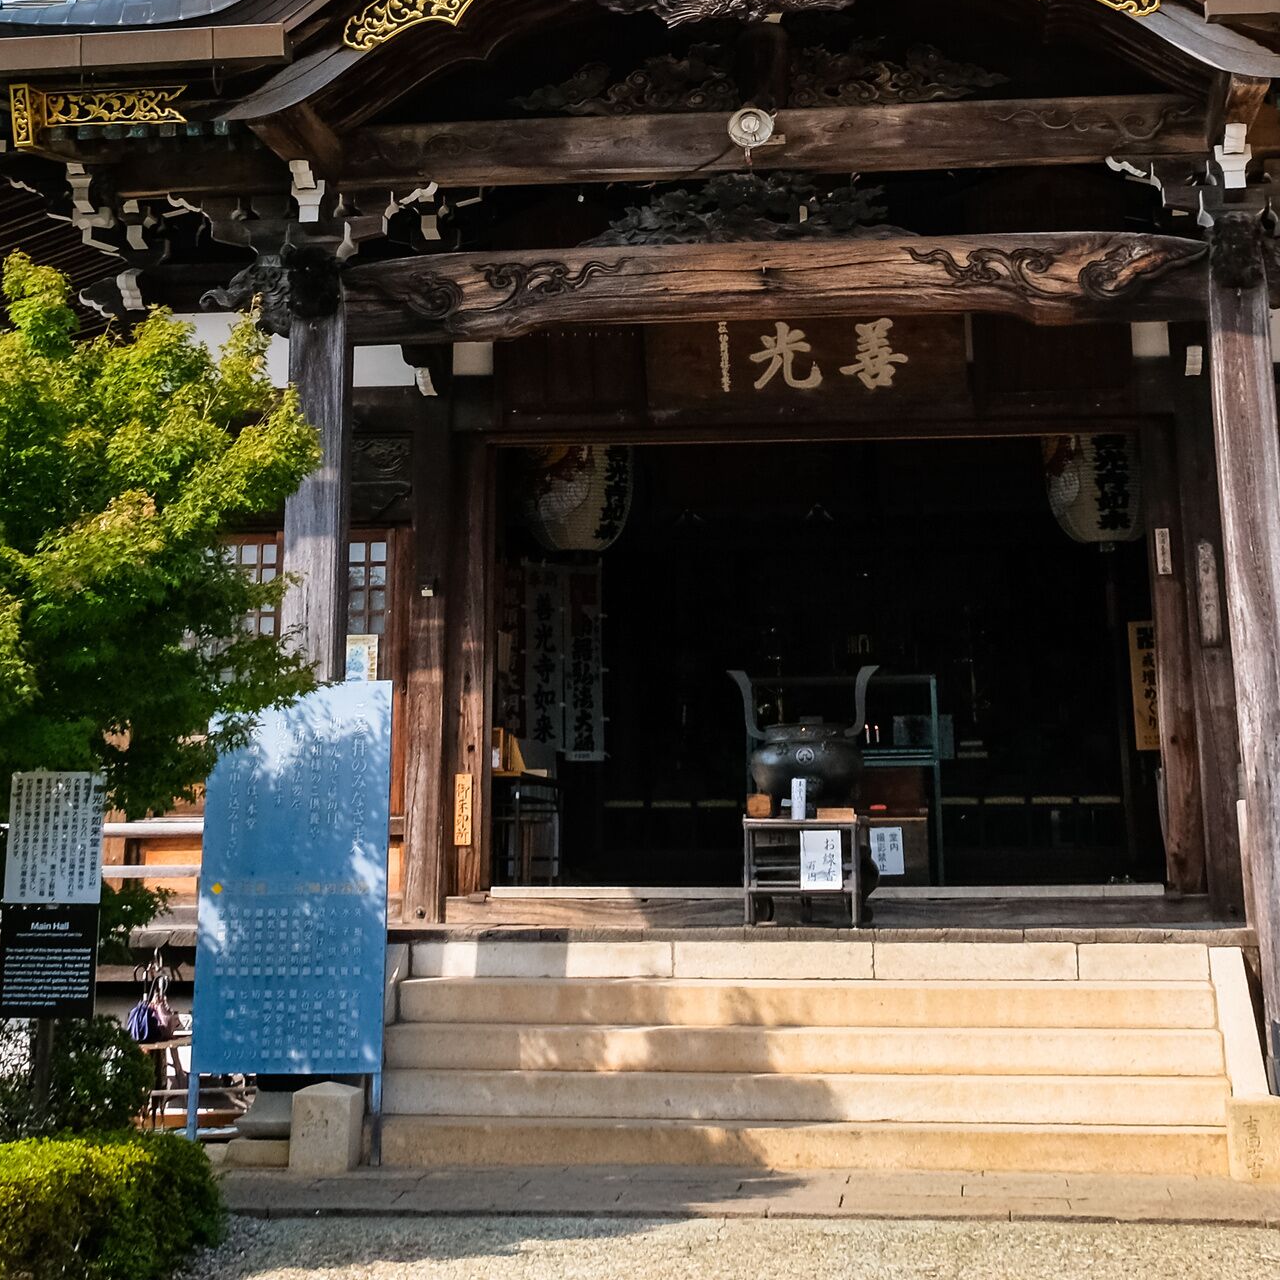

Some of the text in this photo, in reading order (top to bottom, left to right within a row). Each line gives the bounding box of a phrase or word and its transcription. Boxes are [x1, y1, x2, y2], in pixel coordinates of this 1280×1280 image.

[749, 317, 909, 390] 善光
[533, 592, 556, 742] 善光寺如来
[90, 785, 104, 848] 光寺如来堂
[456, 782, 471, 844] 御朱印所
[30, 921, 69, 930] Main Hall
